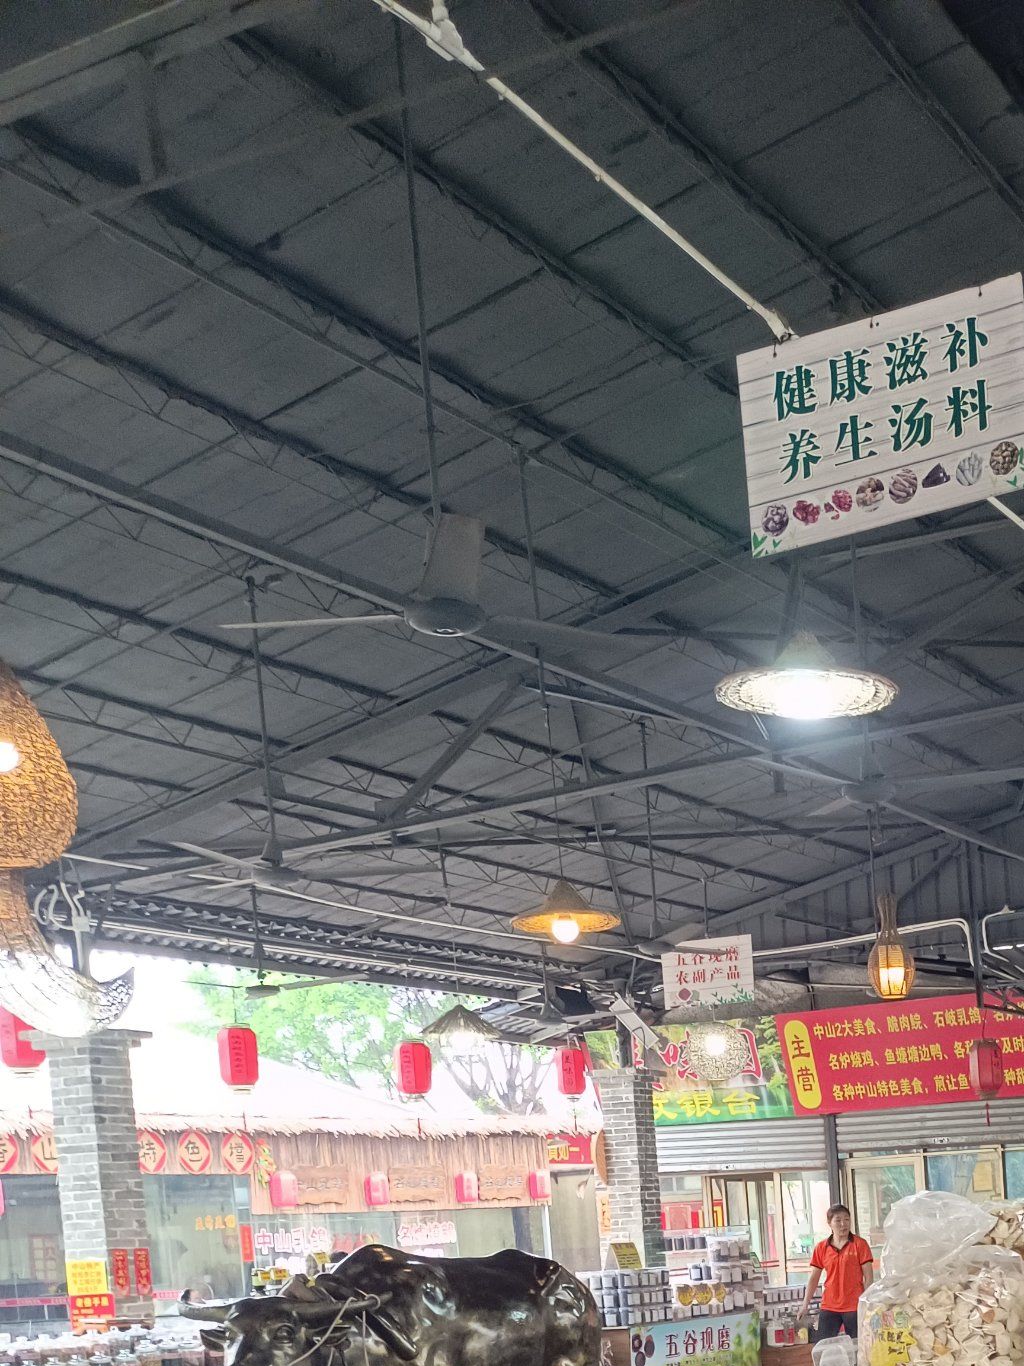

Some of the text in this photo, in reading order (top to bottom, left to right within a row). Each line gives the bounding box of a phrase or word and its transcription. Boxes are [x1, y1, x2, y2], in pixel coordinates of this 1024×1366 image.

[773, 317, 989, 422] 健康滋补
[779, 380, 992, 484] 养生汤料
[676, 965, 740, 985] 农副产品
[792, 1034, 816, 1091] 主营
[665, 1324, 731, 1358] 五谷现磨
